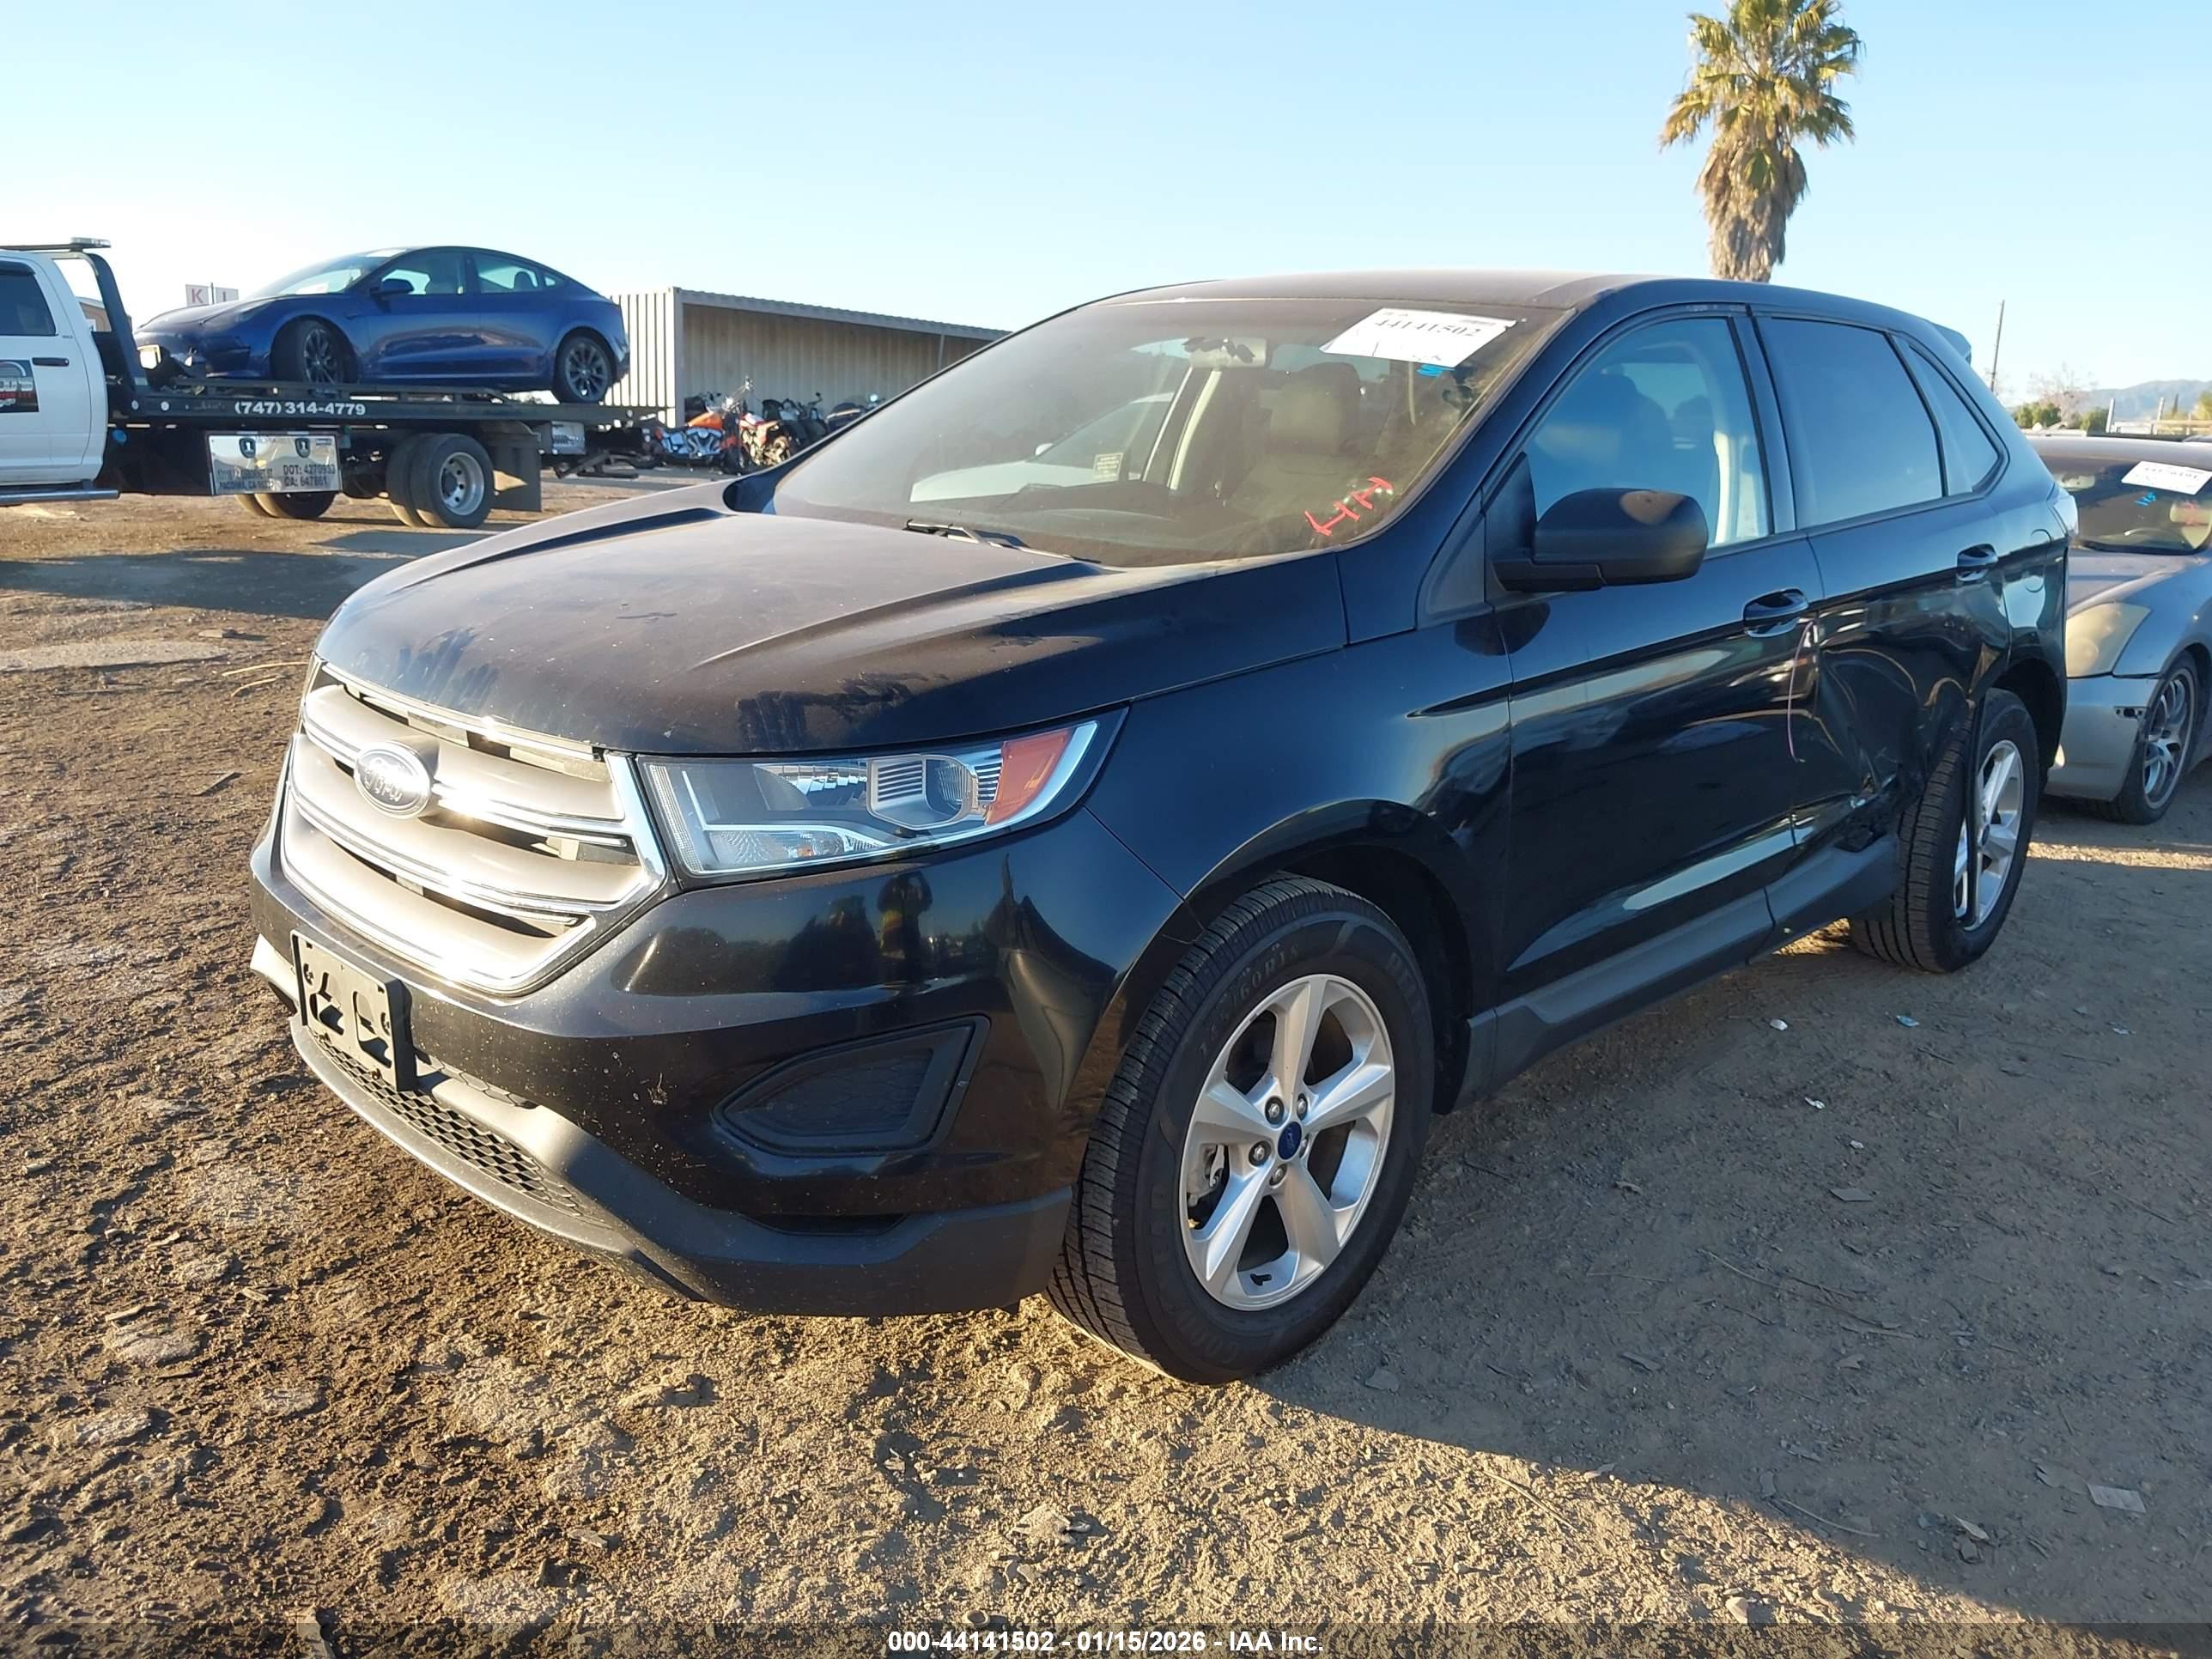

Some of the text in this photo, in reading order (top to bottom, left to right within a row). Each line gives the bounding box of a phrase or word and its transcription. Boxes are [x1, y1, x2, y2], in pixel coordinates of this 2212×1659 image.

[234, 401, 283, 415] (747)
[285, 401, 367, 416] 314-4779
[283, 465, 302, 475] DOT:
